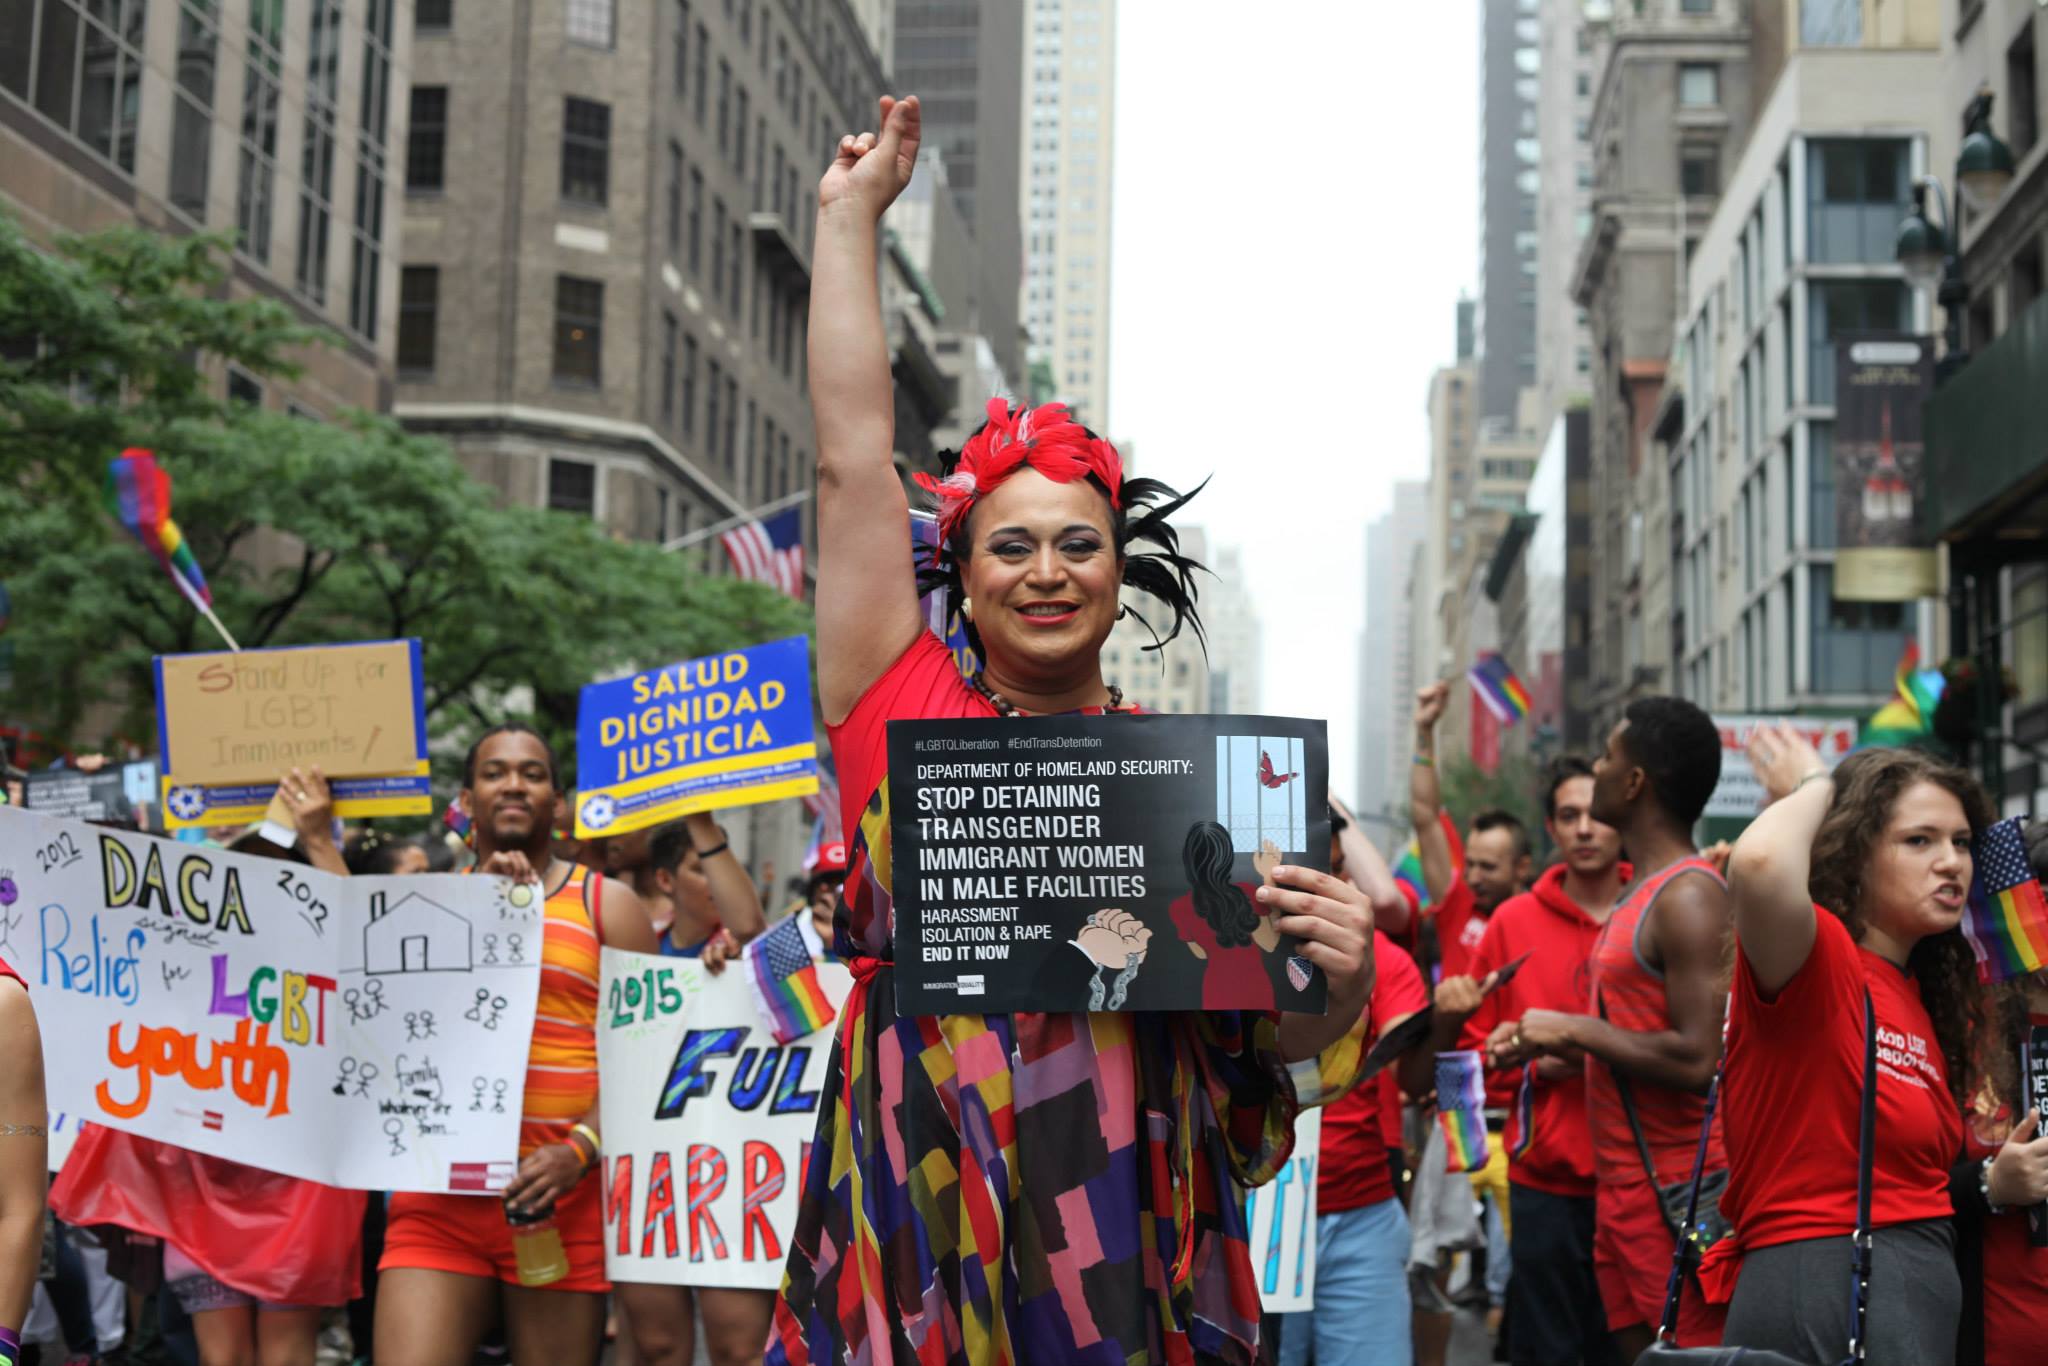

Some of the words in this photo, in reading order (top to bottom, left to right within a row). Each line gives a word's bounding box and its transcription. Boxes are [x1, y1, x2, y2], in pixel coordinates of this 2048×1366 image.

[197, 655, 288, 695] Stand
[302, 655, 336, 693] Up
[633, 654, 748, 704] SALUD
[243, 694, 340, 730] LGBT
[600, 680, 785, 747] DIGNIDAD
[617, 719, 772, 781] JUSTICIA
[915, 739, 1000, 751] #LGBTQLiberation
[1008, 736, 1102, 748] #EndTransDetention
[917, 763, 1010, 779] DEPARTMENT
[1014, 762, 1033, 777] OF
[1037, 761, 1116, 776] HOMELAND
[1120, 760, 1193, 775] SECURITY:
[917, 786, 975, 810] STOP
[982, 784, 1101, 808] DETAINING
[917, 815, 1101, 840] TRANSGENDER
[36, 831, 81, 874] 2012
[919, 846, 1050, 870] IMMIGRANT
[1056, 845, 1145, 868] WOMEN
[99, 834, 255, 935] DACA
[921, 878, 943, 901] IN
[953, 876, 1018, 900] MALE
[1027, 875, 1147, 898] FACILITIES
[921, 907, 1019, 924] HARASSMENT
[922, 926, 995, 943] ISOLATION
[1000, 926, 1010, 940] &
[1015, 925, 1052, 940] RAPE
[40, 903, 146, 1006] Relief
[922, 946, 952, 962] END
[957, 946, 970, 960] IT
[975, 945, 1010, 960] NOW
[208, 954, 337, 1056] LGBT
[609, 968, 684, 1030] 2015
[95, 1018, 290, 1119] youth
